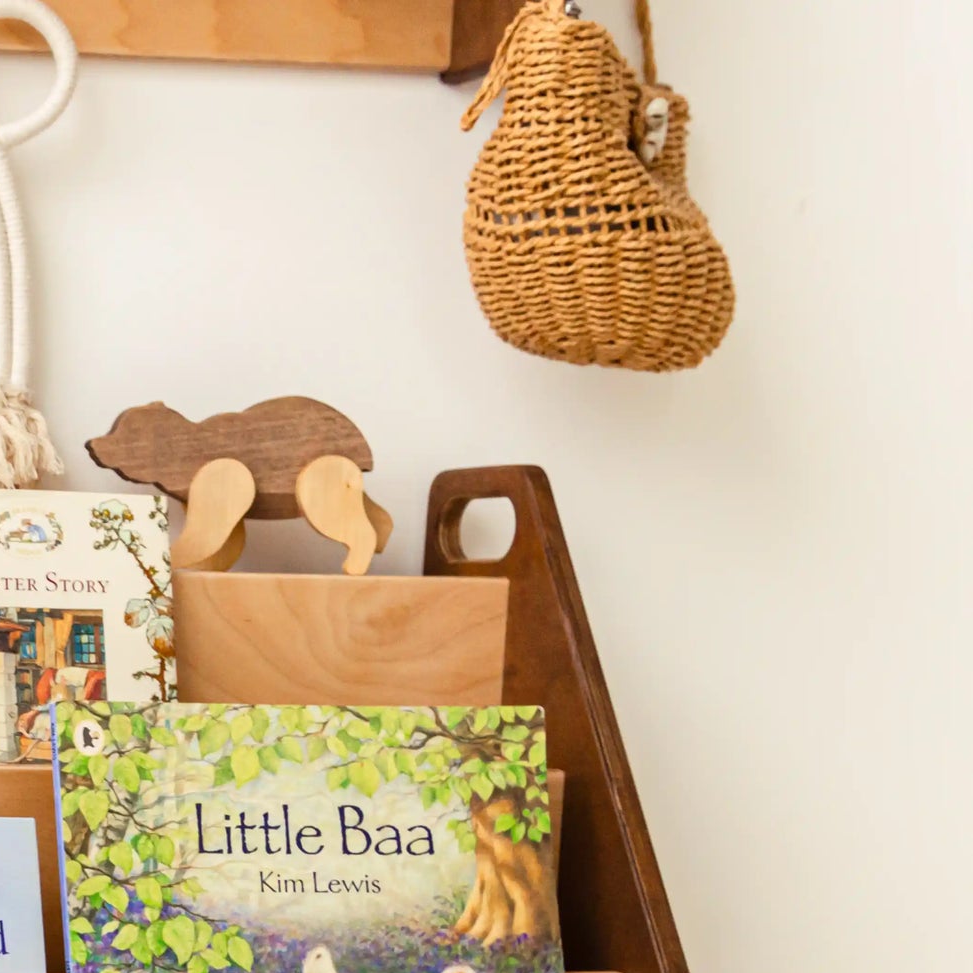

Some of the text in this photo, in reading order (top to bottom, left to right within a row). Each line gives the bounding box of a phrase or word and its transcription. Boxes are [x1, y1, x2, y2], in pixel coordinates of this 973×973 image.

[44, 571, 110, 594] STORY
[195, 802, 435, 856] Little Baa
[259, 870, 382, 895] Kim Lewis
